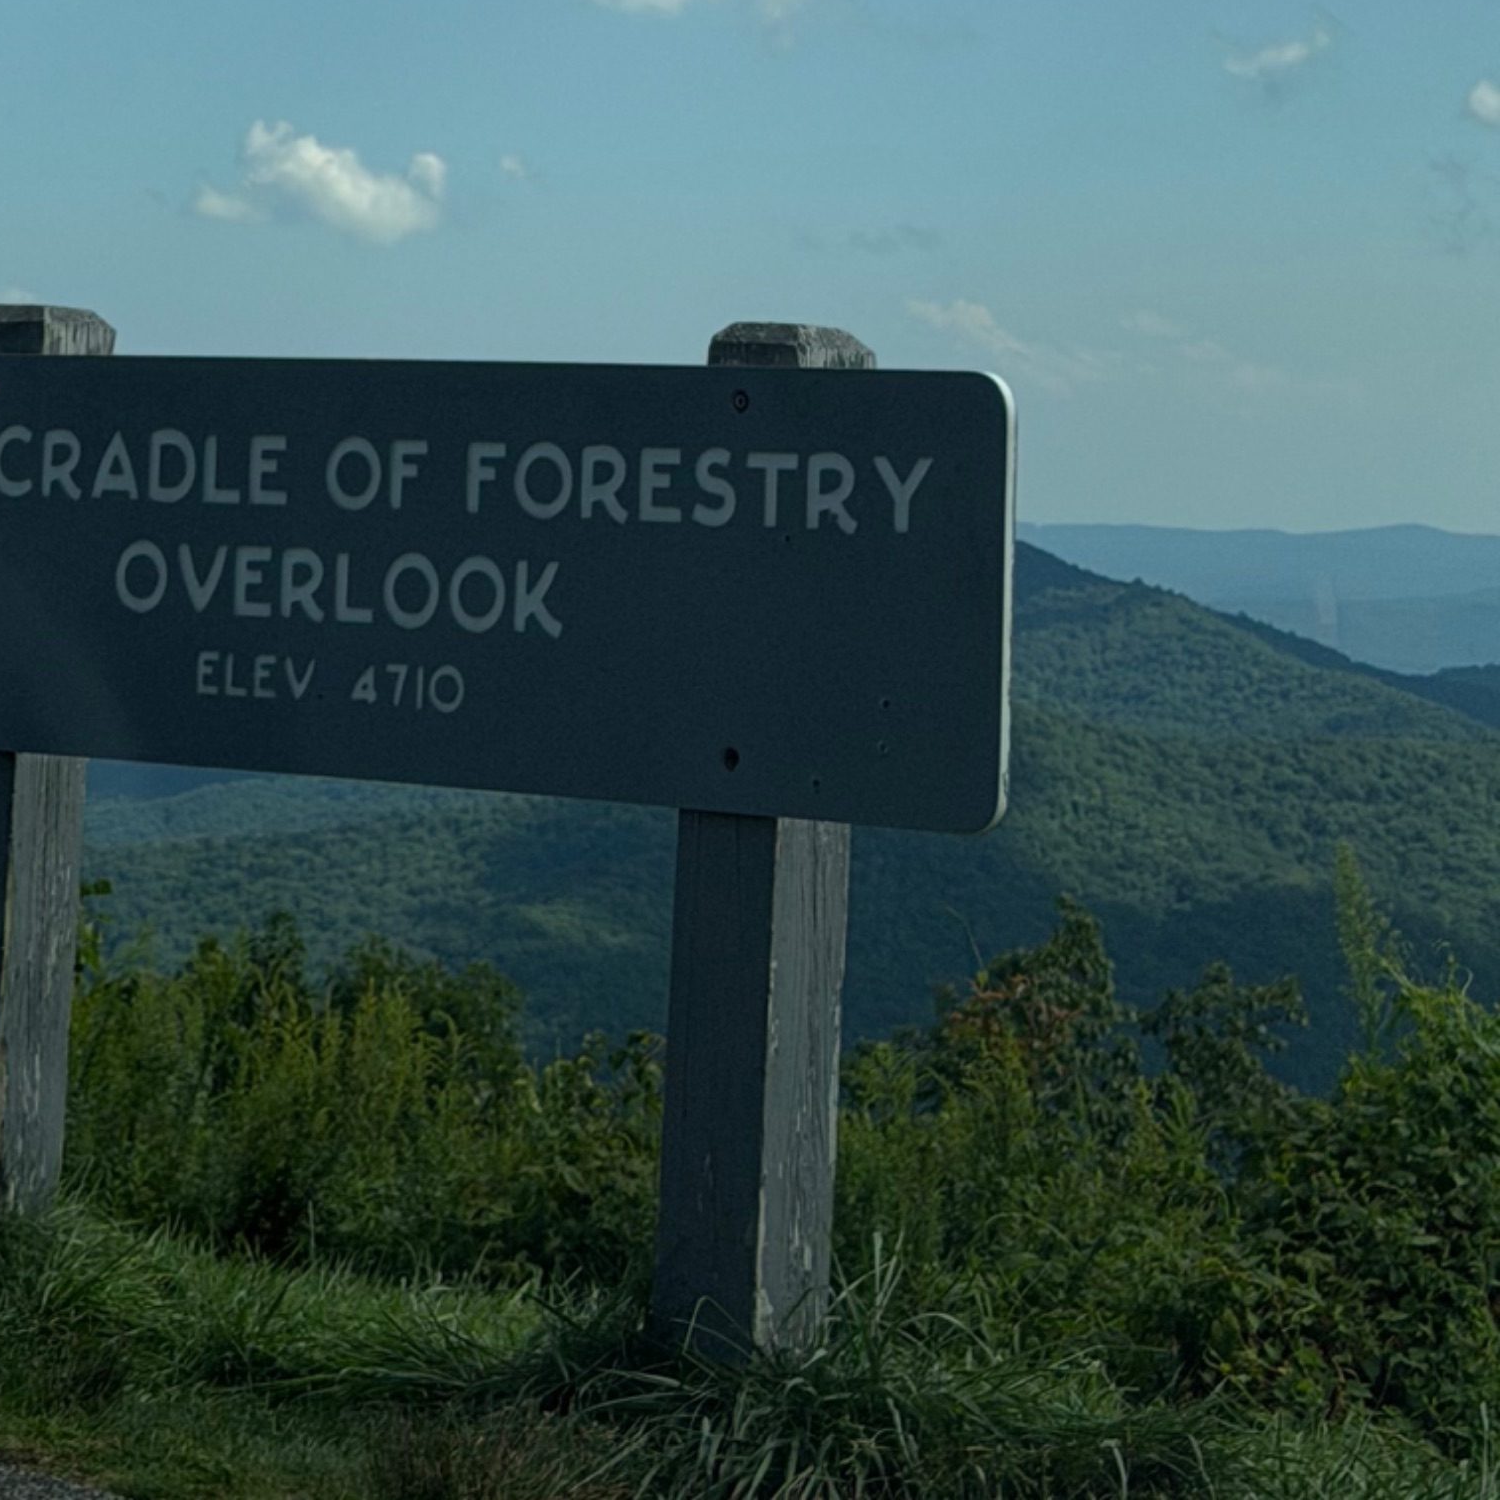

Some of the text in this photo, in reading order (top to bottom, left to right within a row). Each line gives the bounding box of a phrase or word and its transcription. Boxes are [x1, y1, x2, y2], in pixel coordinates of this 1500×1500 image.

[326, 437, 428, 510] OF
[467, 442, 933, 534] FORESTRY
[115, 540, 562, 638] OVERLOOK
[197, 651, 464, 713] ELEV 4710
